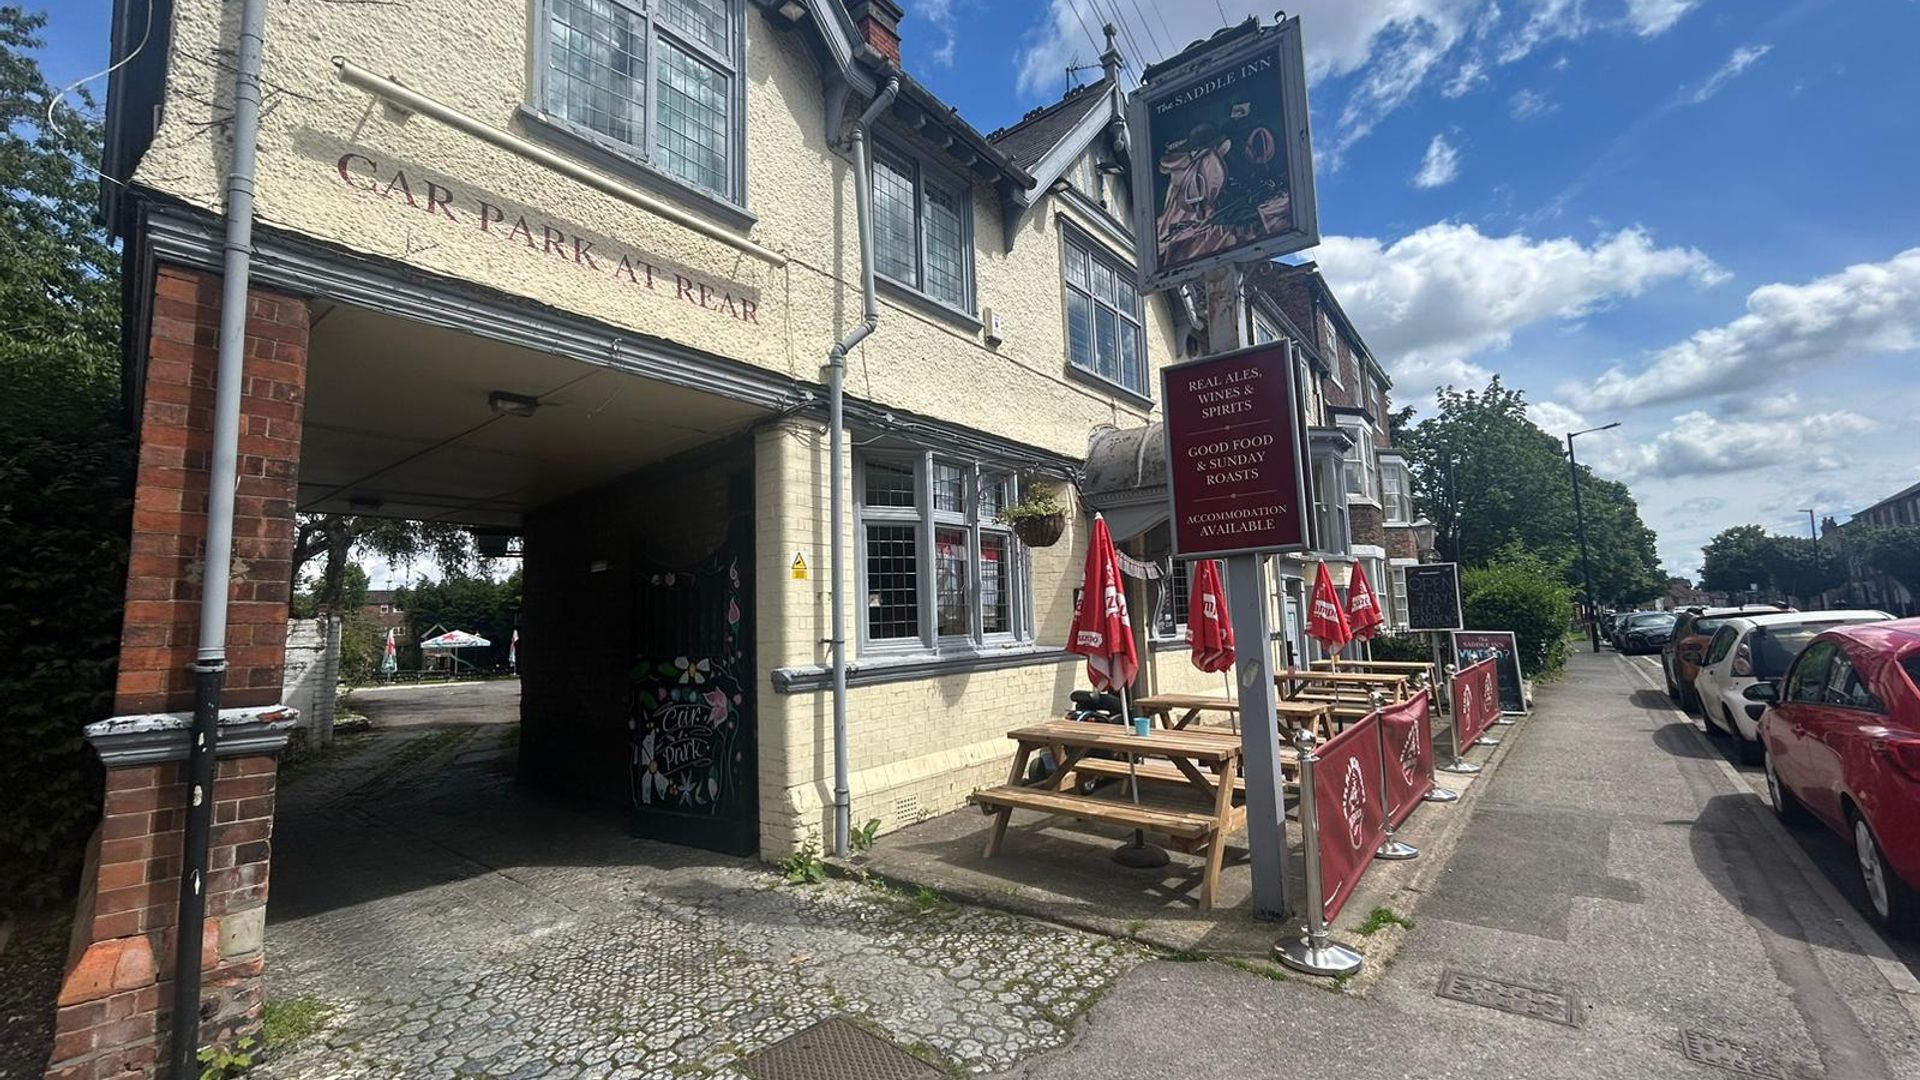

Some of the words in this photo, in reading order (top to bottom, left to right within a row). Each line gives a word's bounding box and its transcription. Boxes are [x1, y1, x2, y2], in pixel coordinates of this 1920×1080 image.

[1156, 102, 1176, 115] The
[1175, 71, 1237, 107] SADDLE
[1240, 55, 1272, 78] INN
[337, 152, 458, 223] CAR
[479, 201, 599, 271] PARK
[614, 253, 661, 290] AT
[674, 272, 760, 325] REAR
[1188, 376, 1222, 392] REAL
[1197, 386, 1241, 404] WINES
[1243, 384, 1255, 396] &
[1201, 400, 1253, 419] SPIRITS
[1188, 441, 1229, 458] GOOD
[1232, 434, 1274, 451] FOOD
[1196, 460, 1207, 472] &
[1209, 451, 1266, 470] SUNDAY
[1206, 468, 1259, 486] ROASTS
[1186, 504, 1288, 525] ACCOMMODATION
[1200, 518, 1276, 537] AVAILABLE
[1407, 577, 1454, 591] OPEN
